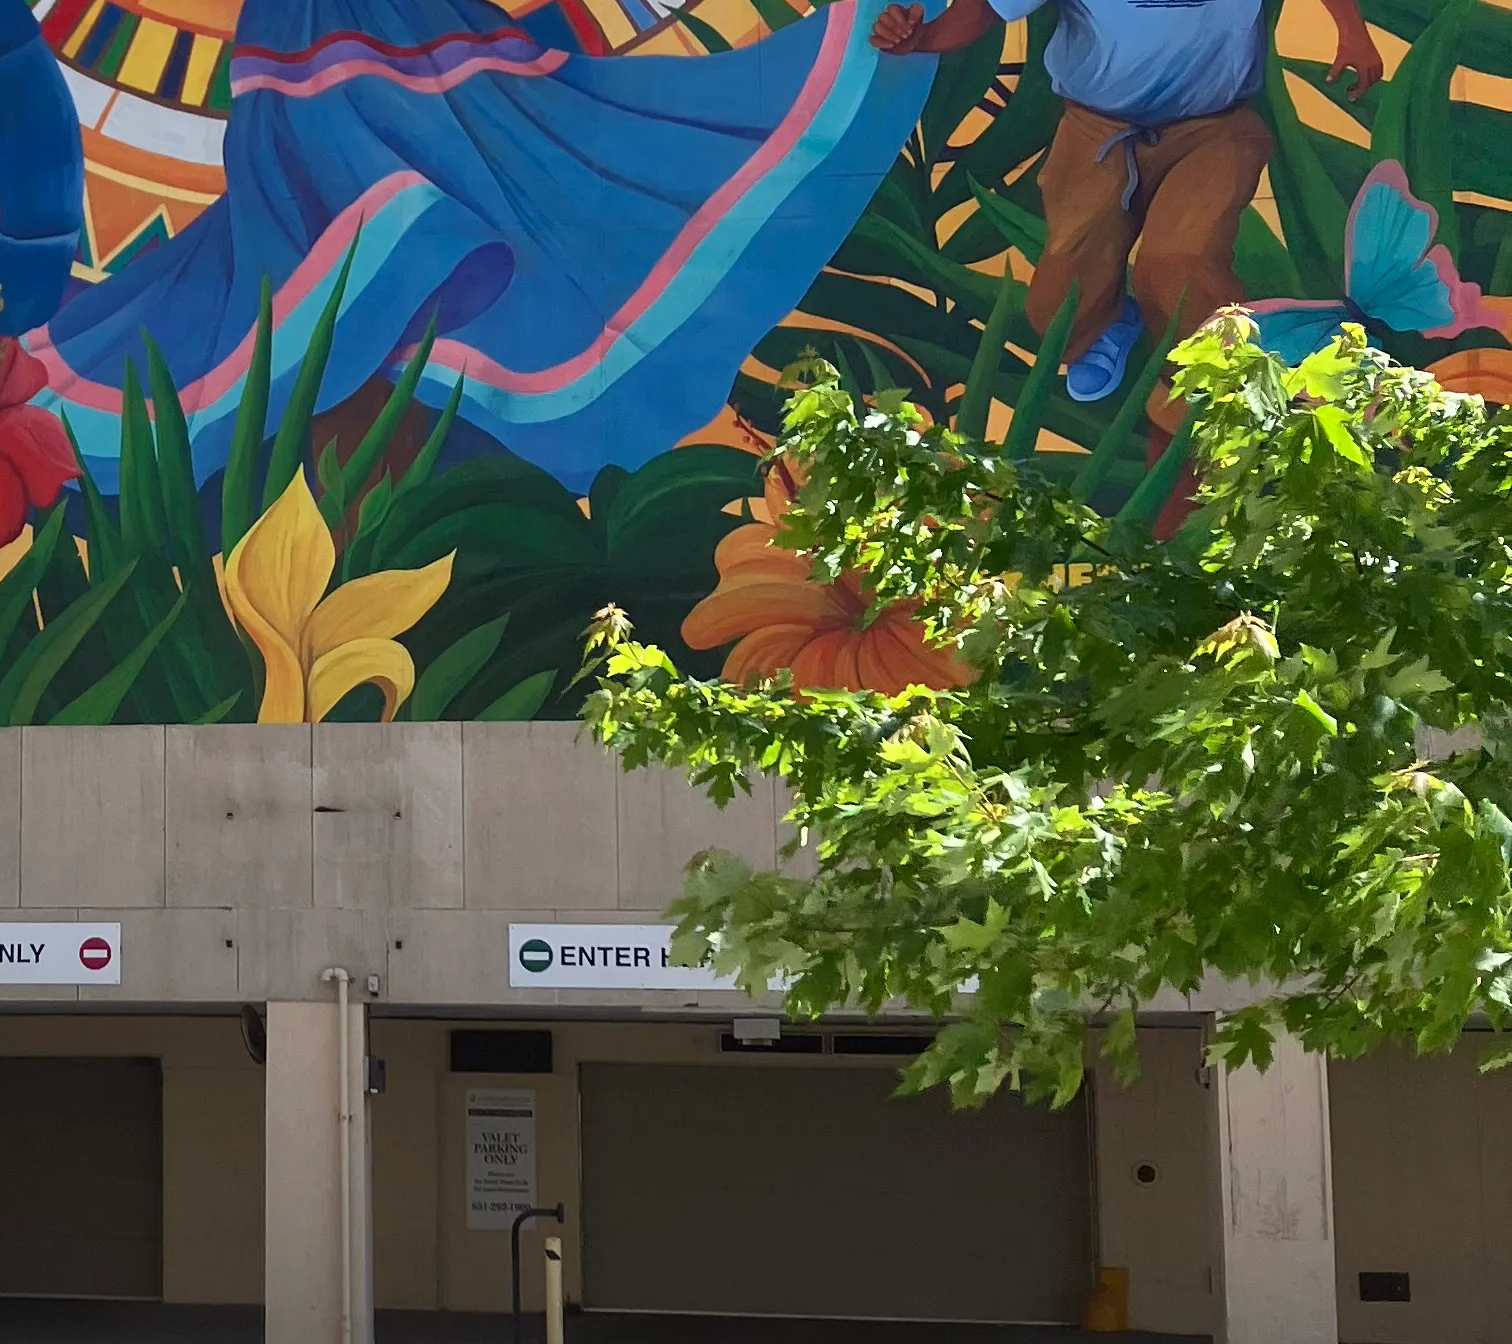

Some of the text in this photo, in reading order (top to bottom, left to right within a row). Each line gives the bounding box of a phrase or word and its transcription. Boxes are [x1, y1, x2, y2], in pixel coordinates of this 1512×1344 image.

[560, 946, 651, 967] ENTER
[481, 1132, 520, 1143] VALET
[474, 1143, 528, 1154] PARKING
[484, 1154, 517, 1165] ONLY
